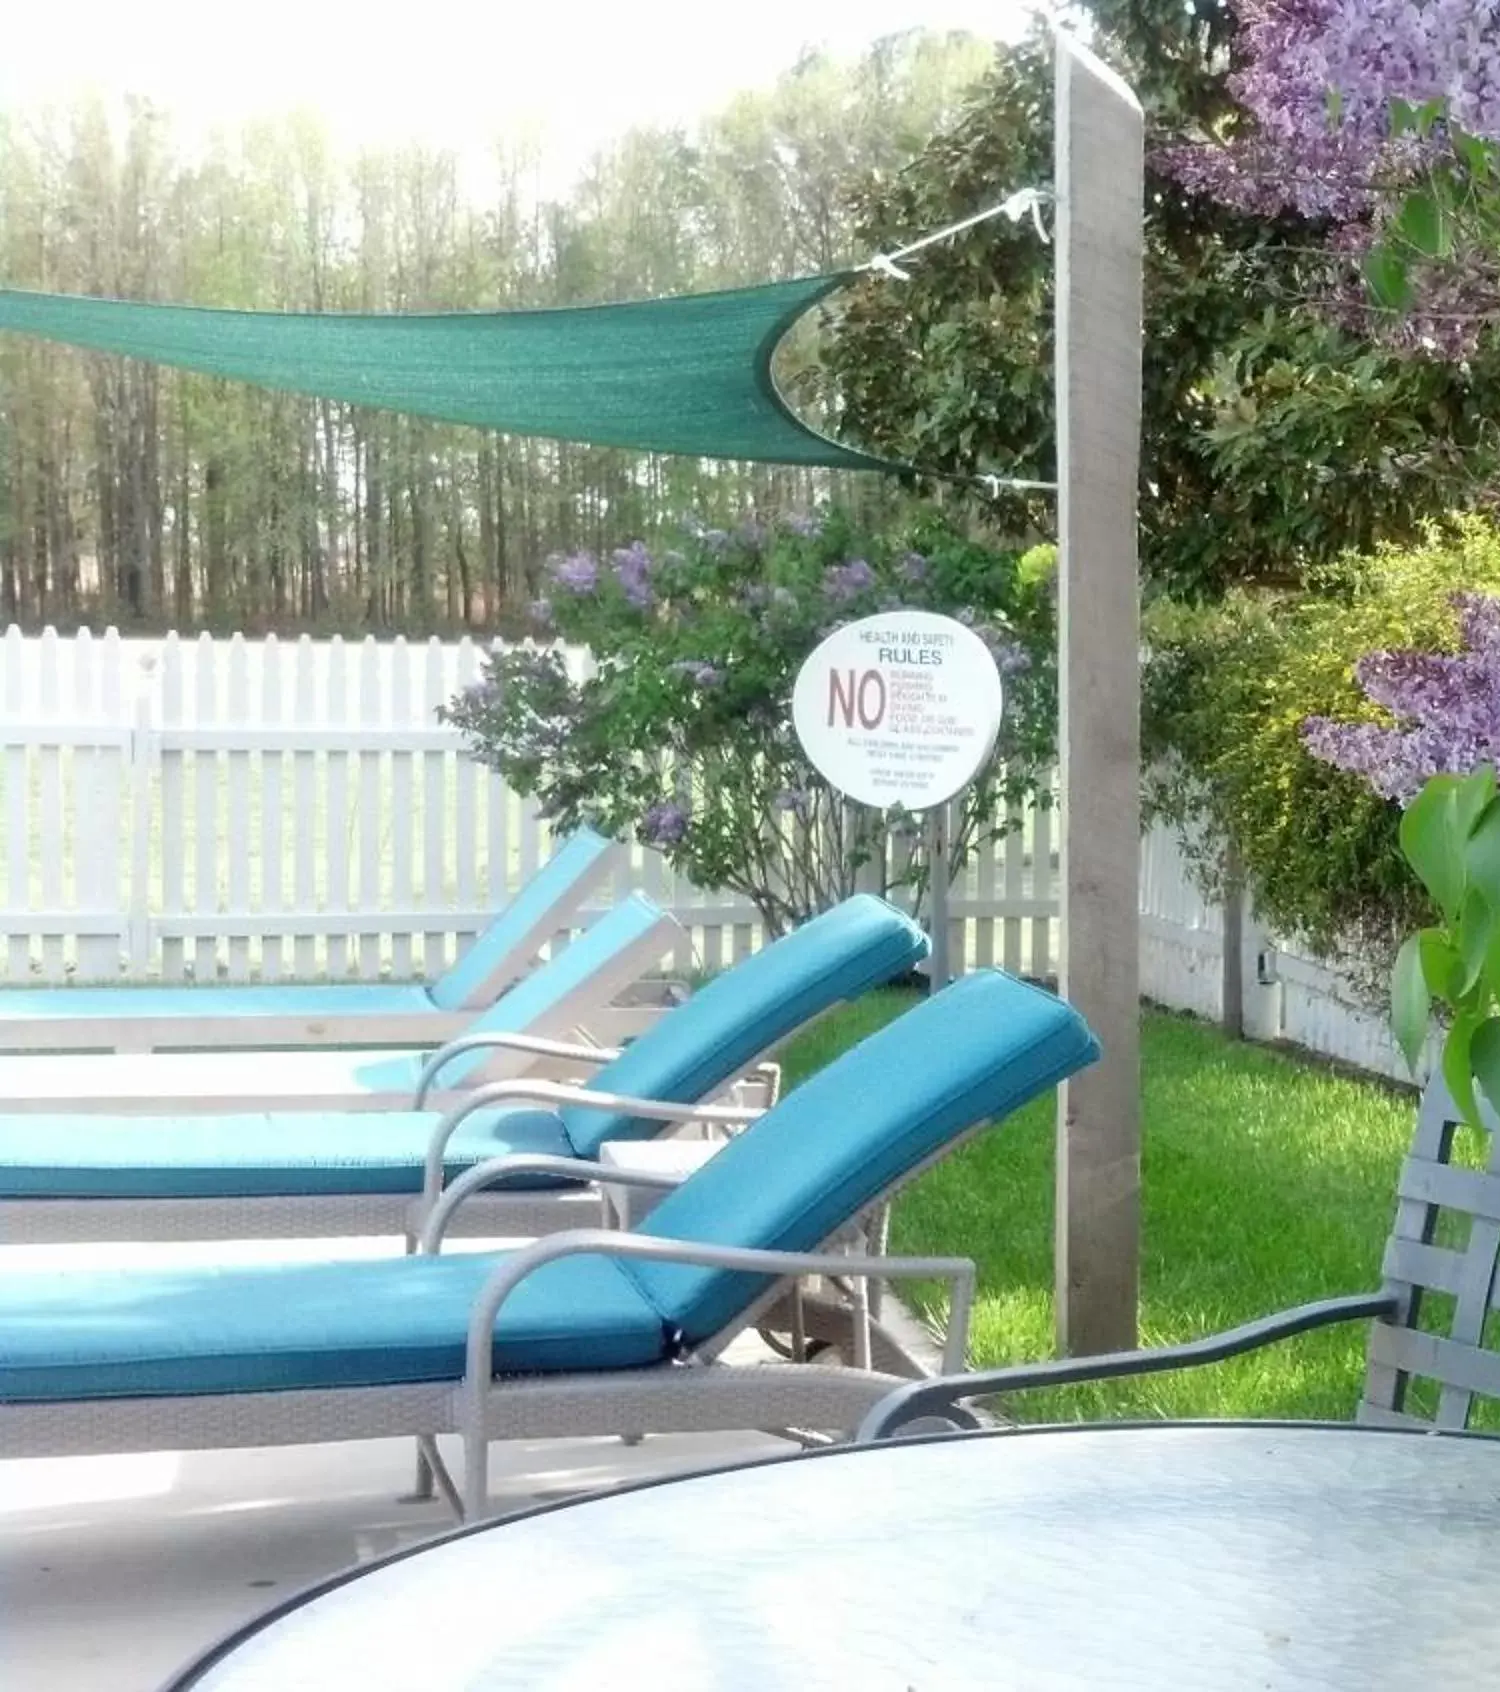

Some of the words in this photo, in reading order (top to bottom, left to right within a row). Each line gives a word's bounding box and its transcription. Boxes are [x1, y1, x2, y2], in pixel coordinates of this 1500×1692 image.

[859, 632, 898, 645] HEALTH
[901, 632, 920, 646] AND
[922, 633, 953, 647] SAFETY
[879, 649, 943, 666] RULES
[828, 667, 886, 730] NO
